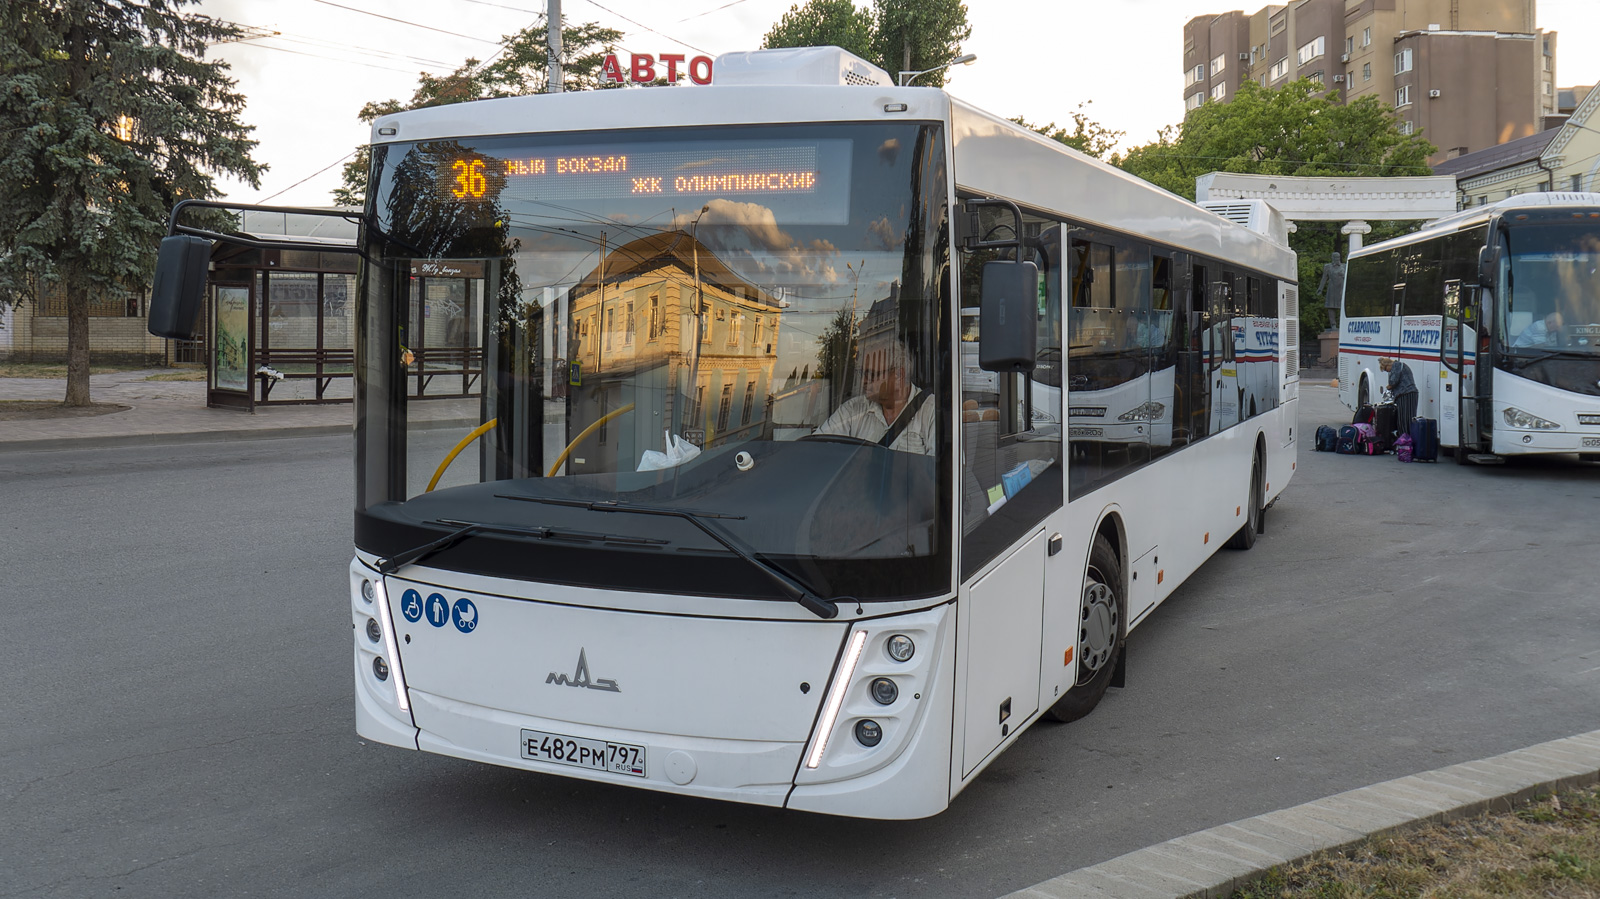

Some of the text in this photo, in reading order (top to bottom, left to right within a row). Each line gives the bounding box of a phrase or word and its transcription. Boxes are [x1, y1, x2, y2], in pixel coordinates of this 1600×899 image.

[598, 53, 713, 86] АВТО
[504, 156, 627, 175] НЫЙ ВОКЗАЛ
[452, 159, 486, 198] 36
[632, 177, 662, 193] ЖК
[1347, 321, 1381, 334] СТАВРОПОЛЬ
[1402, 330, 1440, 344] ТРАНСТУР
[608, 745, 639, 766] 797
[615, 763, 631, 772] RUS
